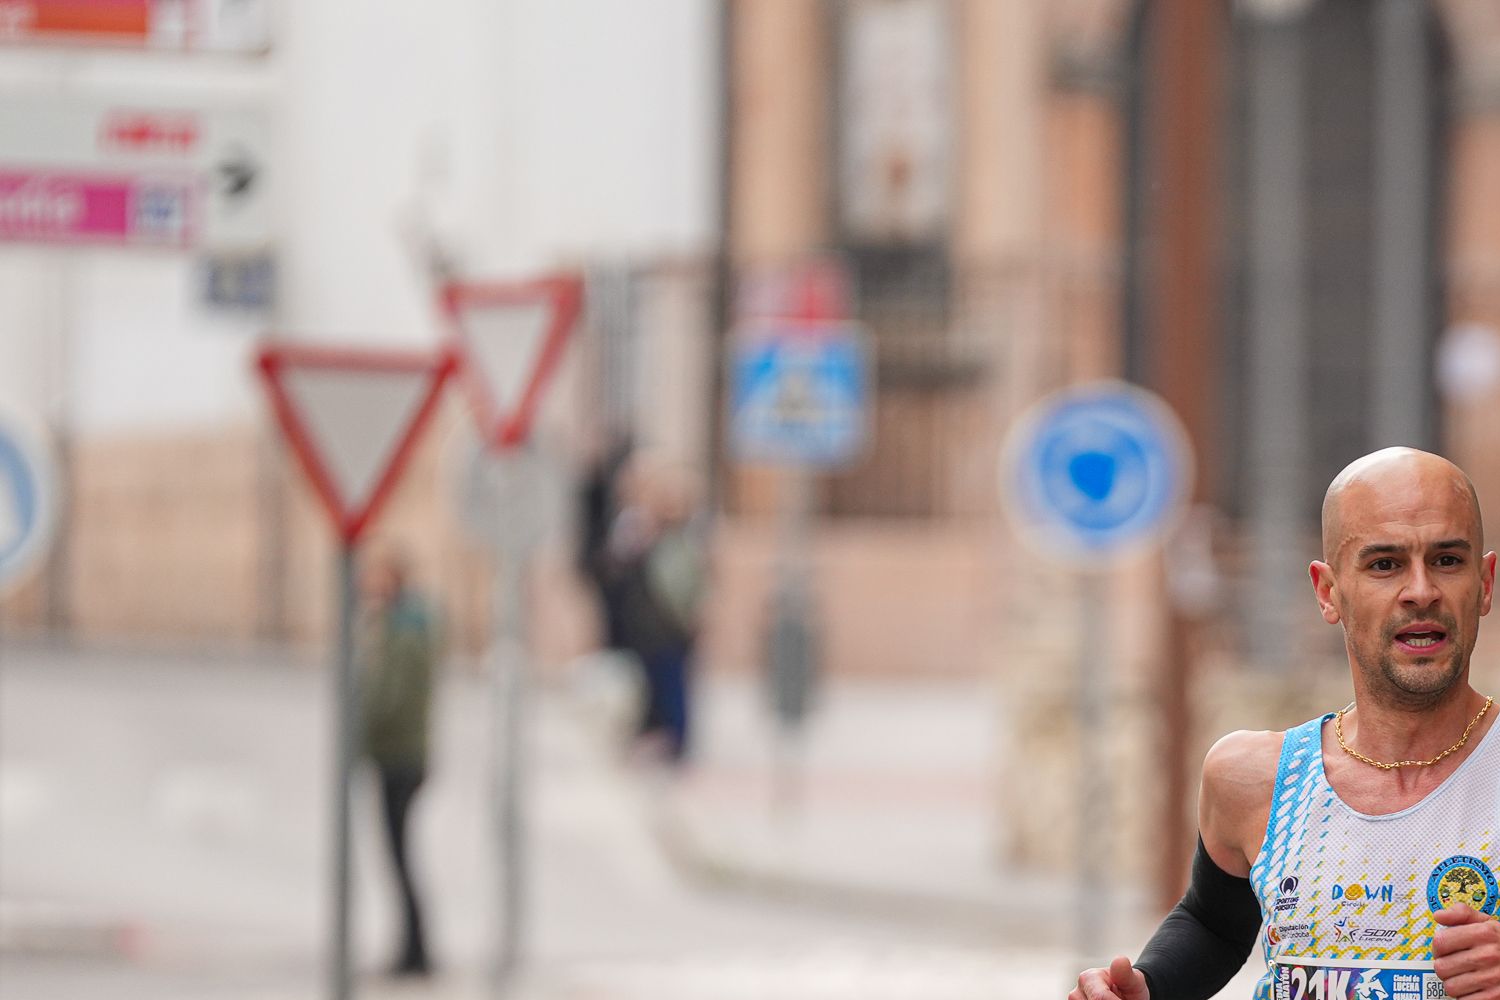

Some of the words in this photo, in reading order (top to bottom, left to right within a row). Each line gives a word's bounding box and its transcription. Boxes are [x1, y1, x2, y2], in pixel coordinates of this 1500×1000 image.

[1432, 856, 1495, 886] ATLETISMO
[1331, 883, 1393, 903] DOWN
[1393, 974, 1413, 982] Ciudad
[1392, 981, 1420, 992] LUCENA
